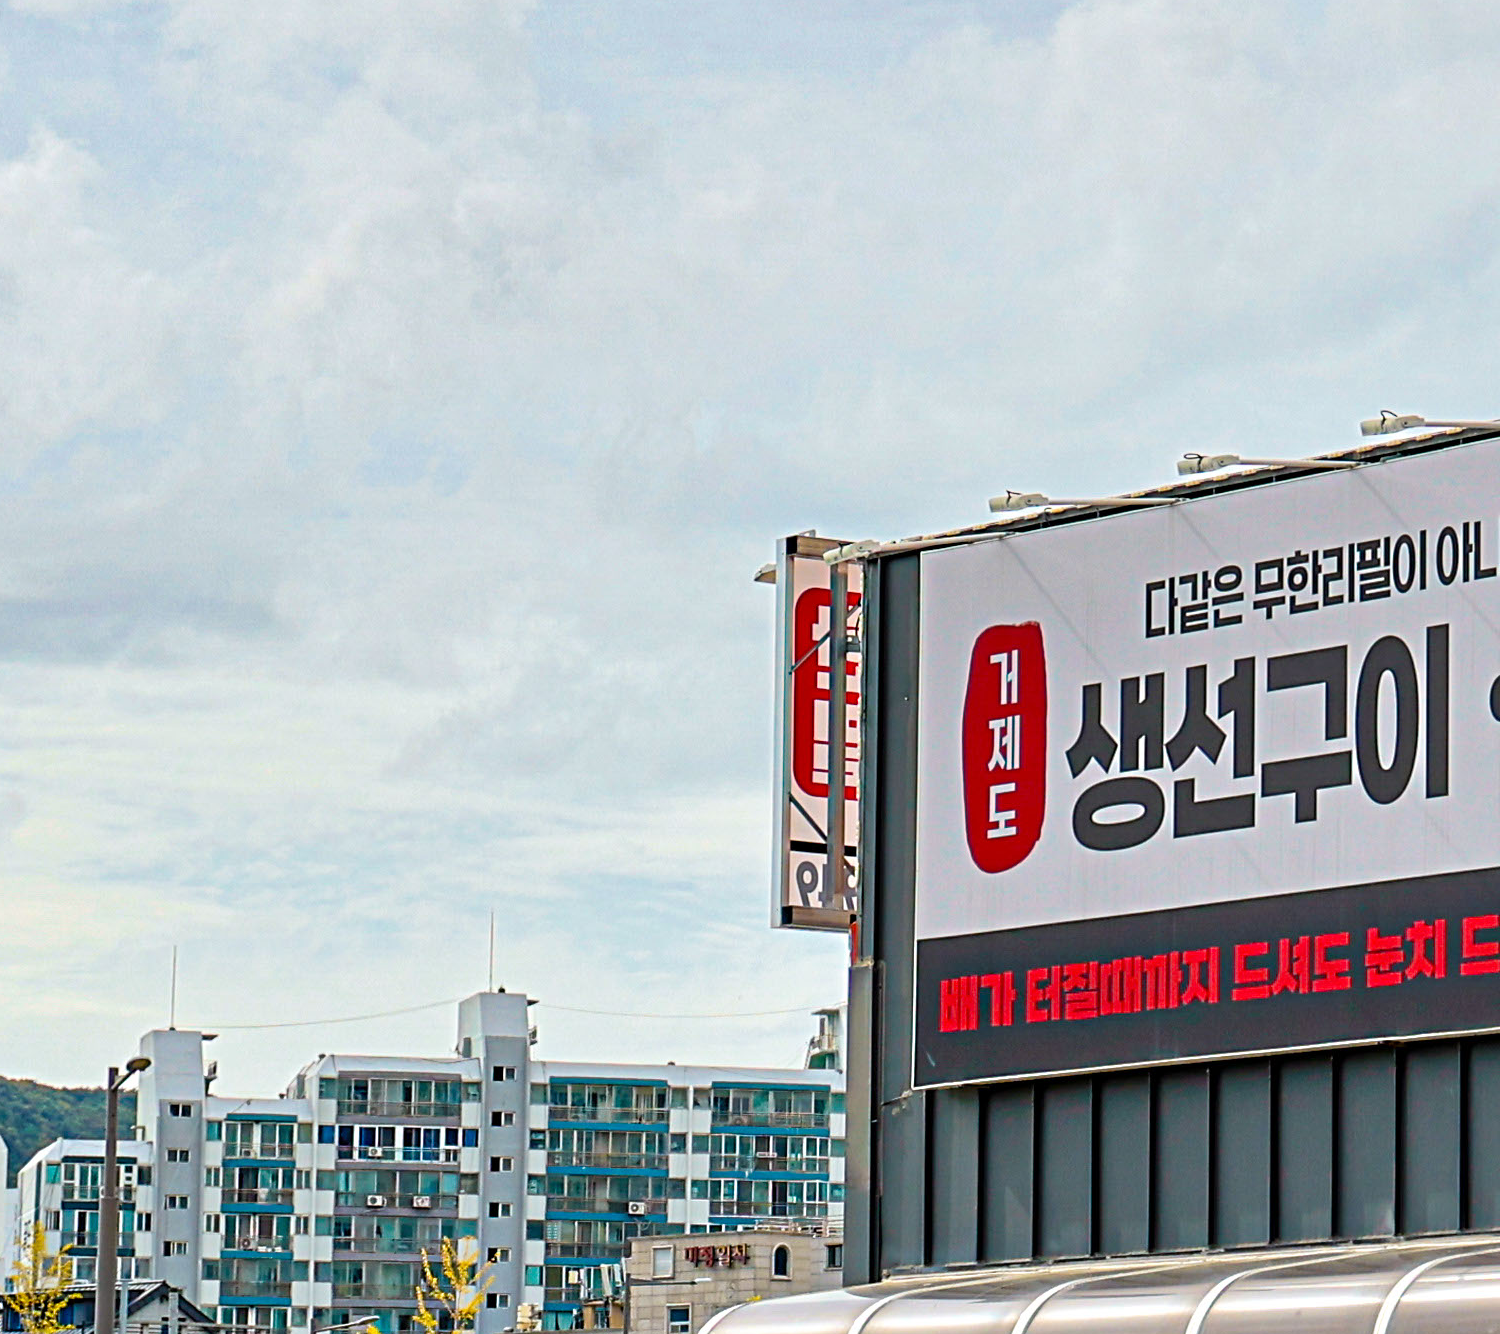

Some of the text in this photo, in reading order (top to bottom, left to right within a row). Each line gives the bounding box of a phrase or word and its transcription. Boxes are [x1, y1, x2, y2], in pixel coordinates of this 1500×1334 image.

[1145, 564, 1244, 638] 다같은
[1253, 530, 1427, 619] 무한리필이
[986, 649, 1020, 840] 거제도
[1065, 622, 1450, 852] 생선구이
[938, 970, 1017, 1033] 배가
[1025, 945, 1221, 1024] 터질때까지
[1231, 931, 1352, 1001] 드셔도
[1365, 917, 1446, 988] 눈치
